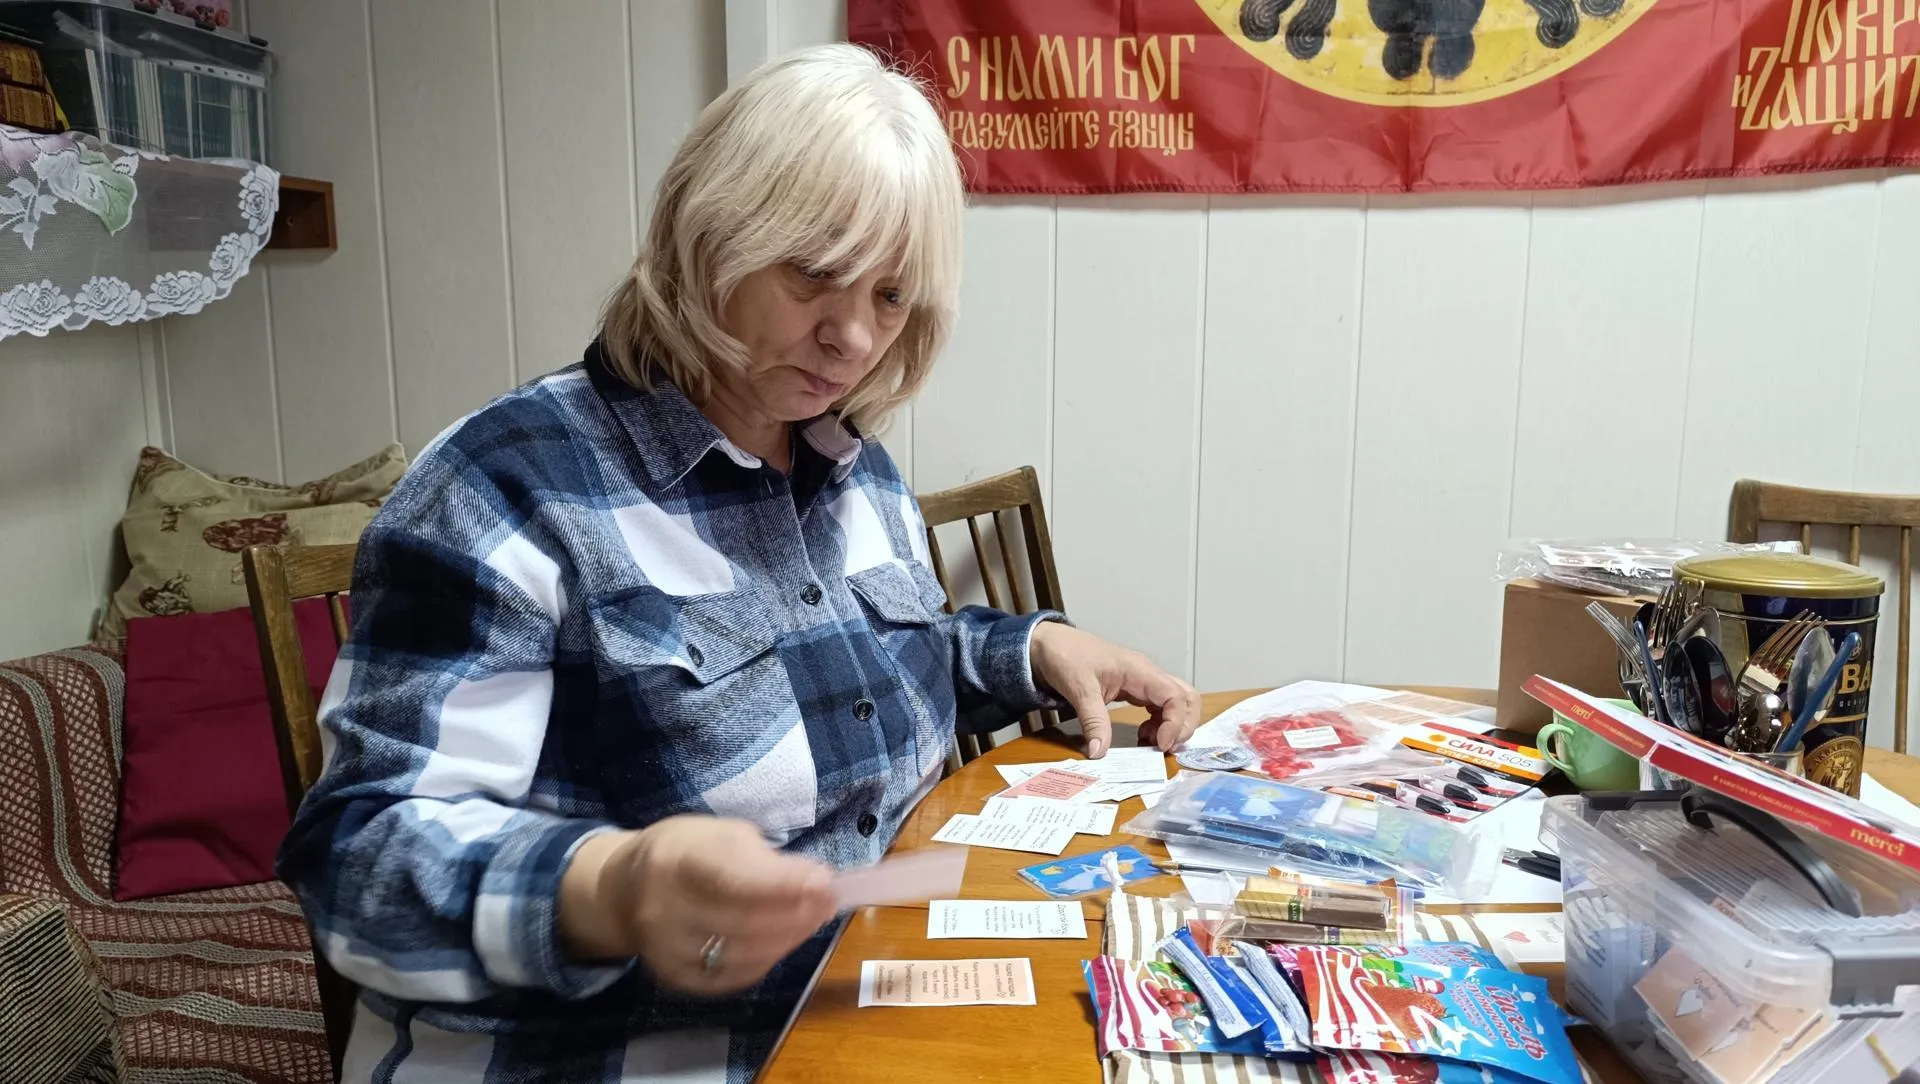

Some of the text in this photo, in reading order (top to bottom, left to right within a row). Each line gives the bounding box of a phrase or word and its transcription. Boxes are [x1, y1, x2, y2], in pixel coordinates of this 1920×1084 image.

[946, 34, 1196, 103] С НАМИ БОГ
[949, 107, 1099, 152] РАЗУМЕЙТЕ
[1448, 738, 1532, 769] СИЛА 505
[1850, 827, 1906, 857] merci
